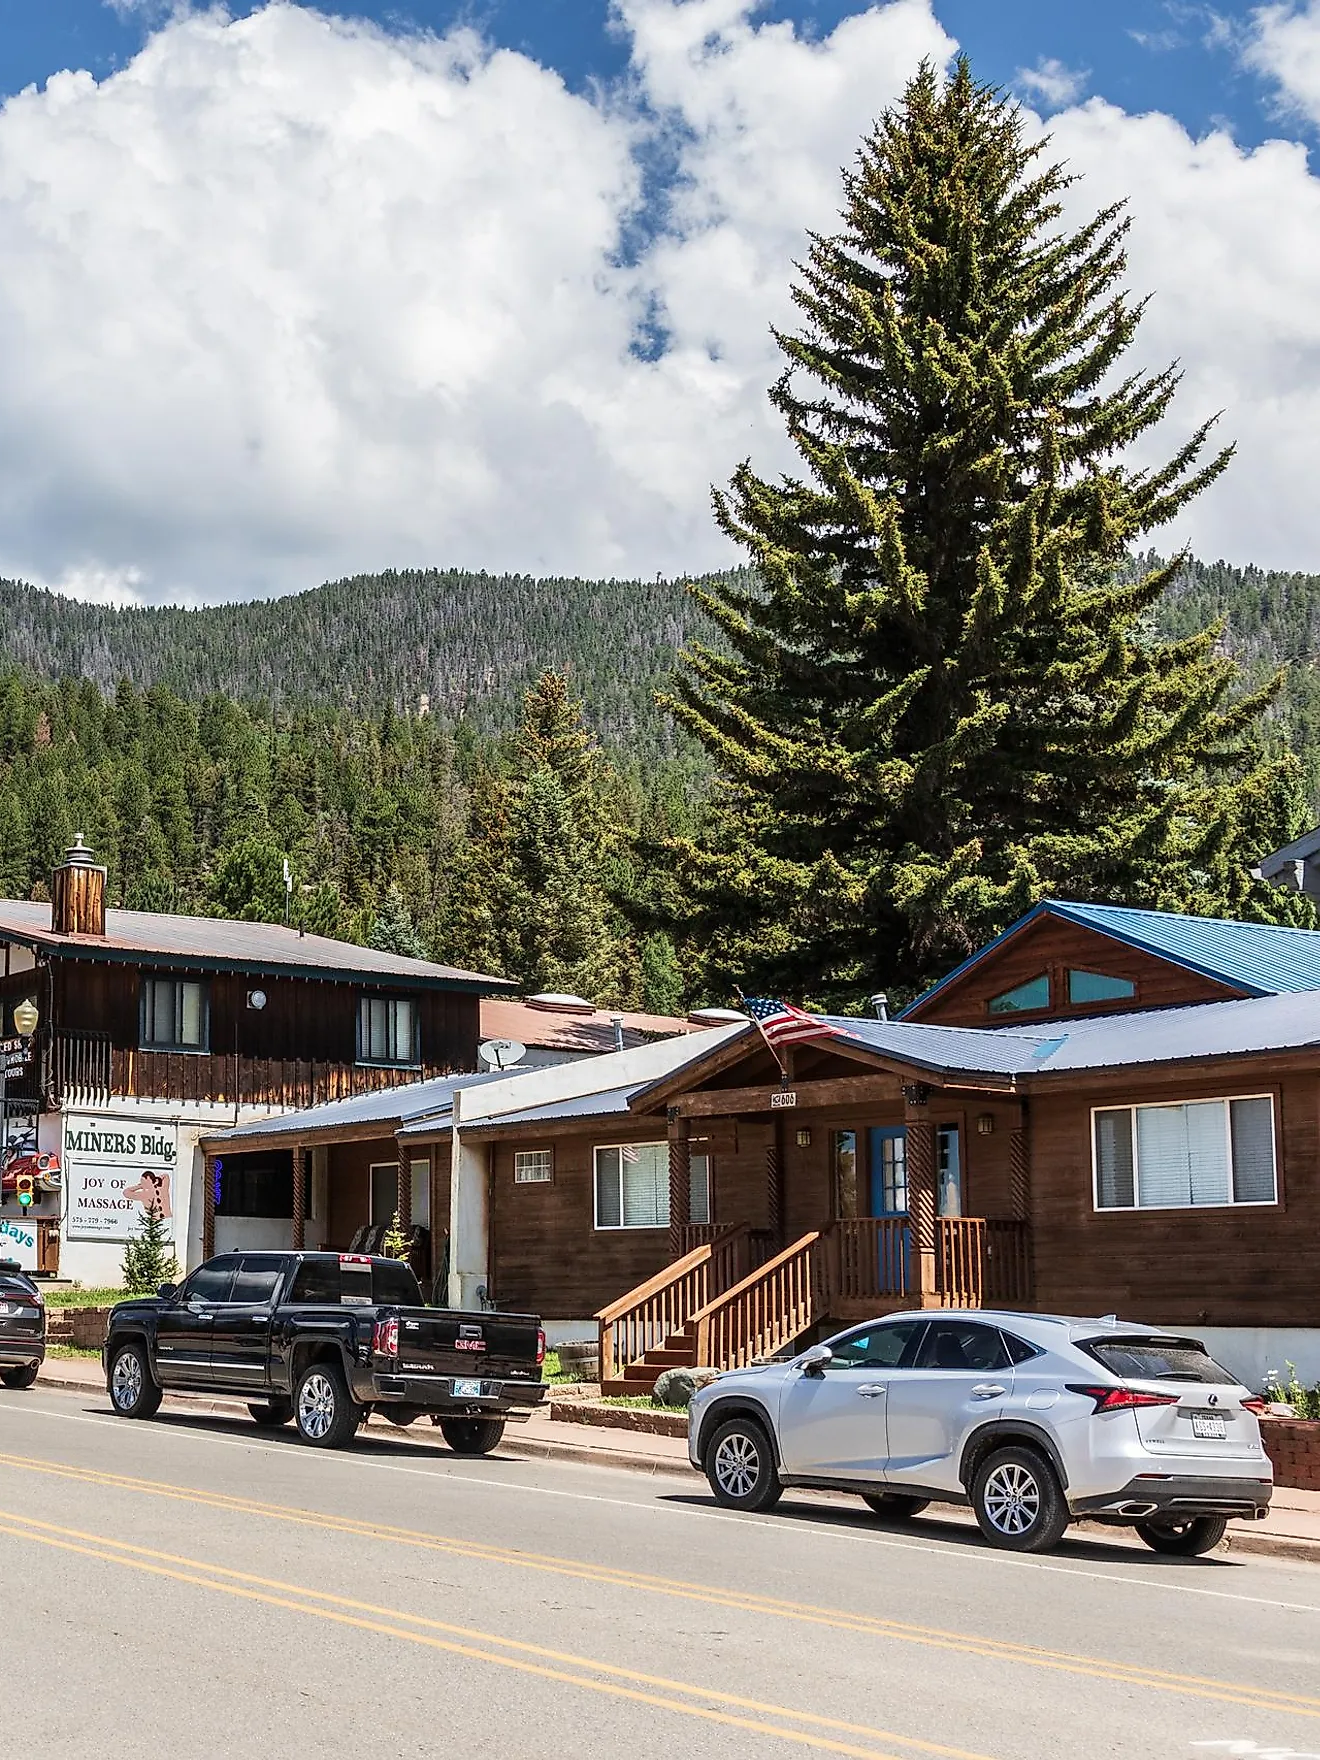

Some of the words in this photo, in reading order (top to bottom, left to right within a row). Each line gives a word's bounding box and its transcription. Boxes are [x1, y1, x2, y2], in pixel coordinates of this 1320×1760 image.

[66, 1131, 136, 1154] MINERS
[140, 1135, 176, 1162] Bldg.
[82, 1178, 105, 1190] JOY
[110, 1179, 127, 1189] OF
[77, 1198, 134, 1210] MASSAGE
